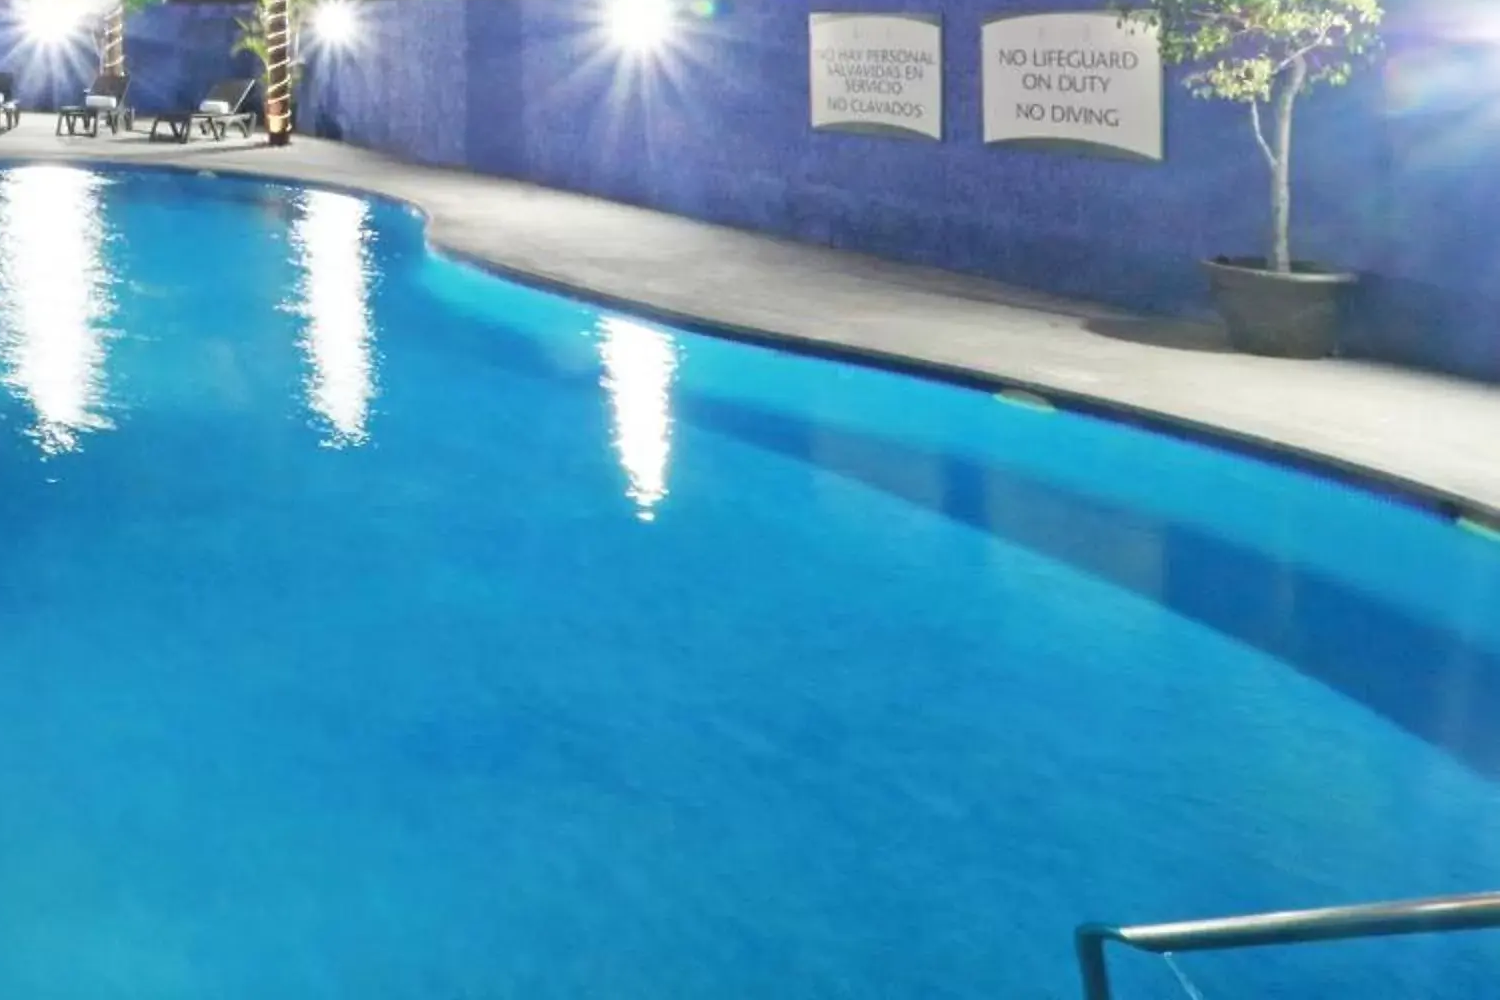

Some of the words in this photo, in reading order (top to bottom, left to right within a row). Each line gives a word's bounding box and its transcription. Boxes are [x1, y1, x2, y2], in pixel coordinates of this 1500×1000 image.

[867, 49, 935, 65] PERSONAL
[999, 48, 1027, 66] NO
[1033, 48, 1139, 70] LIFEGUARD
[905, 65, 924, 80] EN
[1022, 73, 1051, 91] ON
[1058, 74, 1112, 93] DUTY
[827, 96, 847, 112] NO
[850, 98, 925, 118] CLAVADOS
[1016, 103, 1045, 121] NO
[1051, 104, 1119, 127] DIVING
